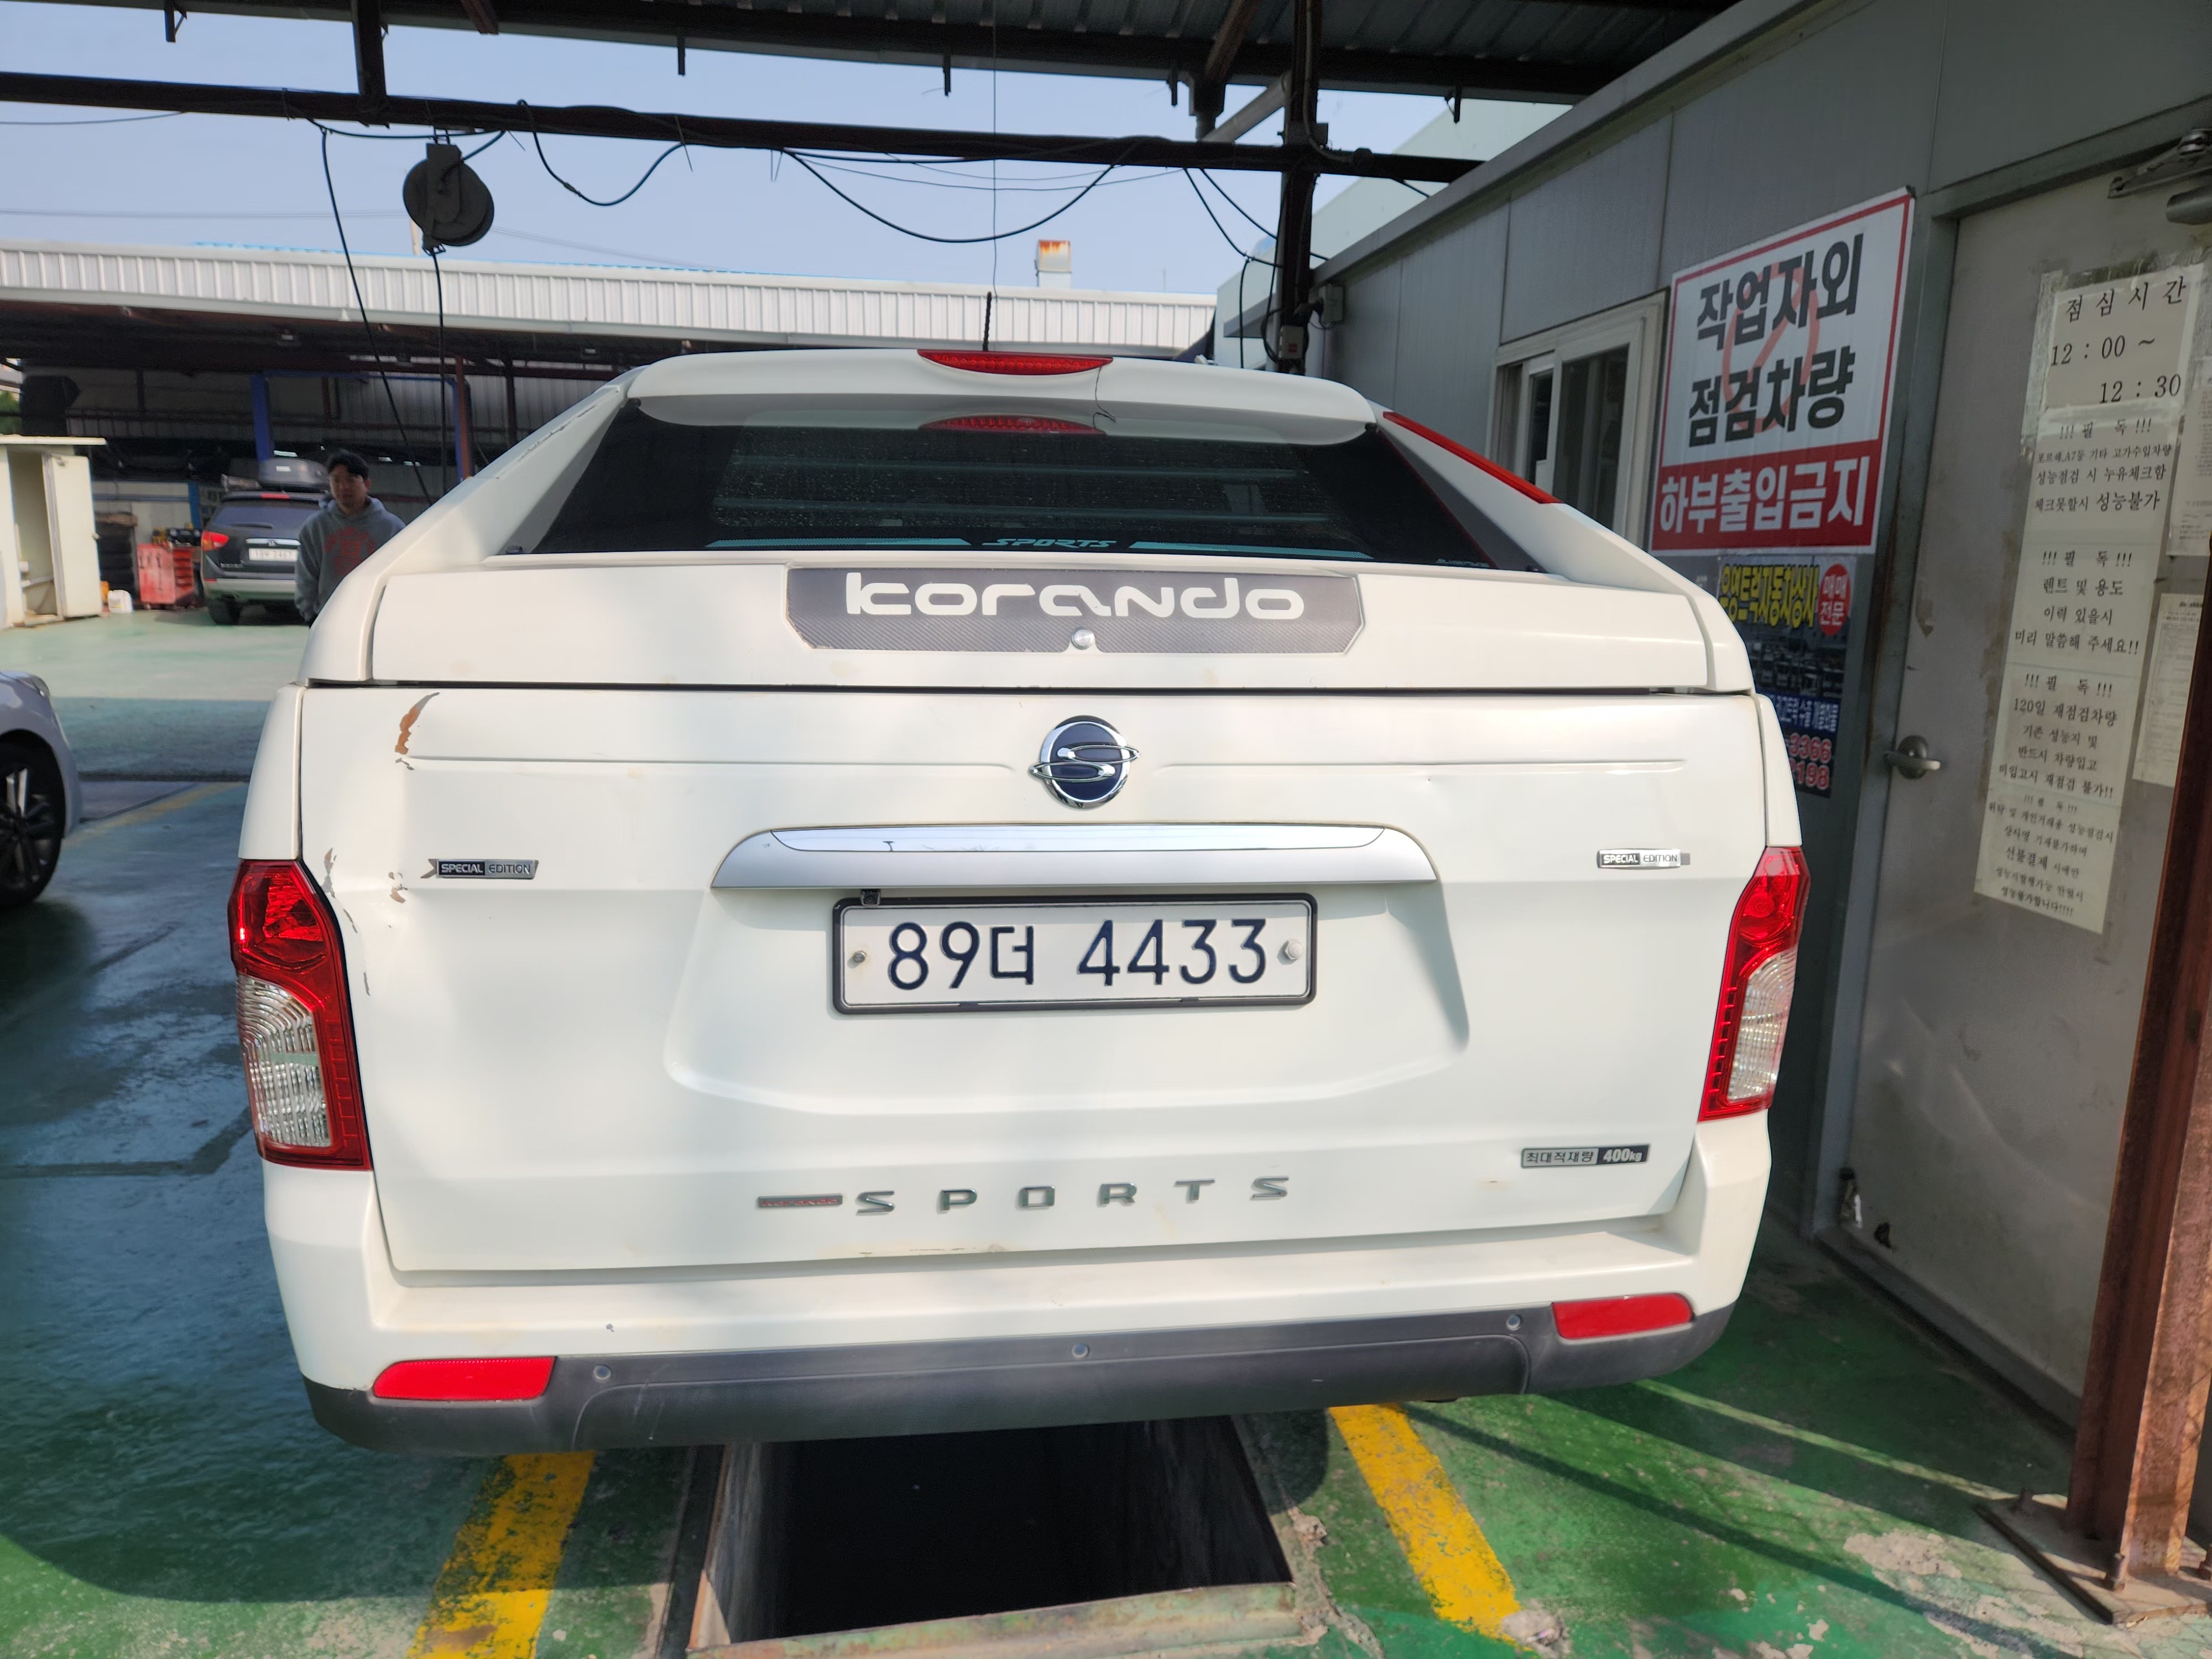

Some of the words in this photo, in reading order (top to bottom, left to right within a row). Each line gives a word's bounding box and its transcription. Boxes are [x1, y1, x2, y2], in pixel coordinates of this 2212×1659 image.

[1697, 233, 1864, 351] 작업자외
[1689, 345, 1856, 447] 점검차량
[2112, 444, 2172, 458] 고가수입차량
[1660, 457, 1870, 534] 하부출입금지
[2096, 489, 2160, 512] 성능불가
[982, 538, 1117, 549] SPORTS
[1823, 573, 1847, 599] 매매
[2043, 576, 2067, 594] 렌트
[2076, 578, 2088, 596] 및
[2095, 578, 2123, 597] 용도
[1818, 601, 1845, 626] 전문
[2075, 607, 2112, 625] 있을시
[2016, 629, 2037, 646] 미리
[2046, 632, 2080, 650] 말씀해
[2088, 635, 2138, 655] 주세요!!
[2014, 698, 2045, 717] 120일
[441, 863, 483, 873] SPECIAL
[488, 864, 530, 874] EDITION
[1603, 854, 1639, 864] SPECIAL
[1643, 854, 1677, 863] EDITION
[888, 920, 1035, 990] 89더
[1077, 917, 1267, 987] 4433
[1527, 1151, 1594, 1164] 최대적재량
[1603, 1148, 1642, 1162] 400kg
[857, 1176, 1289, 1214] SPORTS
